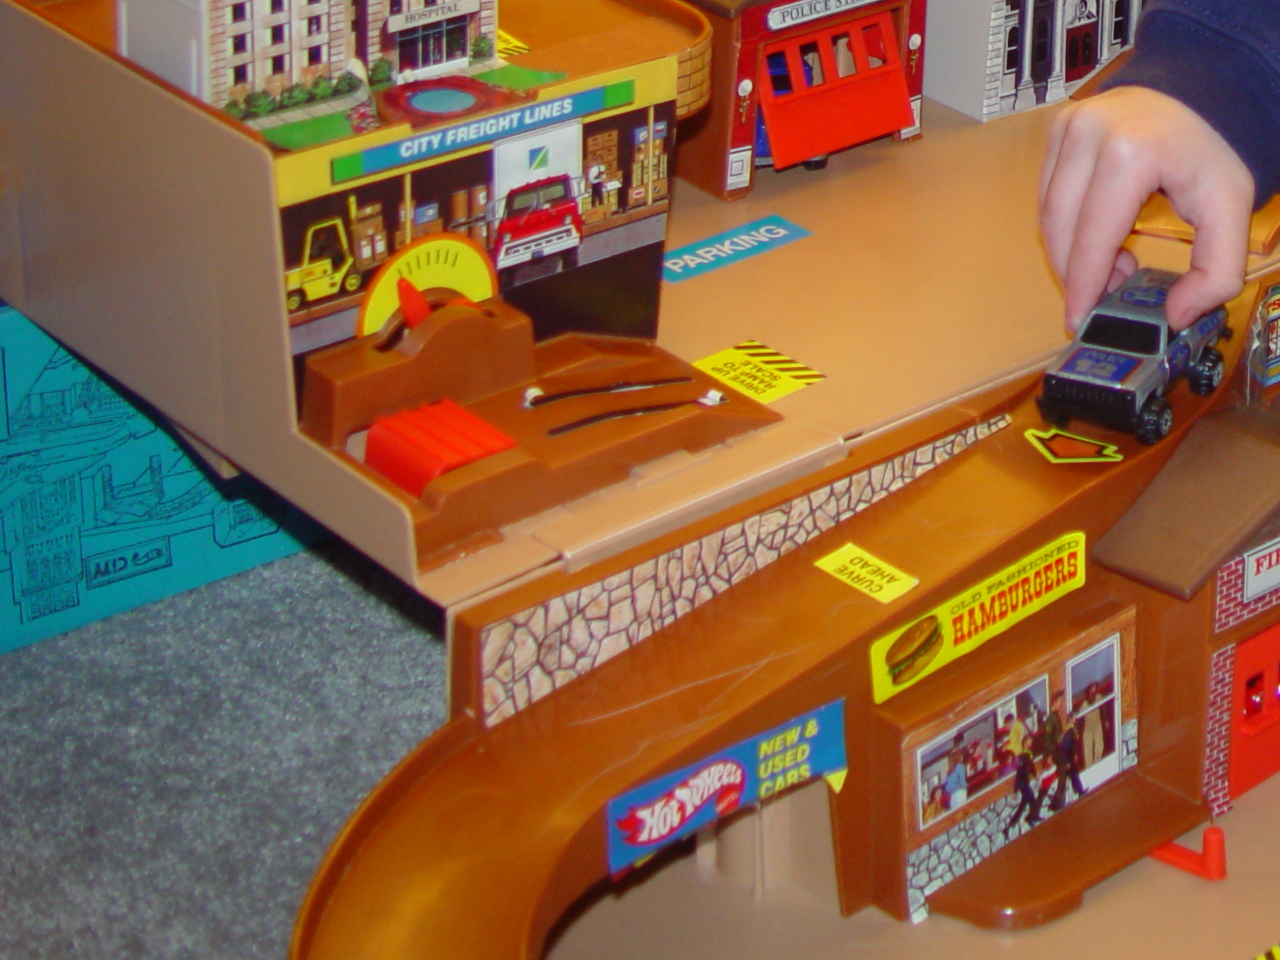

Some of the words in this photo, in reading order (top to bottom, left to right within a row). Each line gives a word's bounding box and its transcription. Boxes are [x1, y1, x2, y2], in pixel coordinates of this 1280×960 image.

[405, 3, 460, 24] HOSPITAL
[780, 0, 831, 24] POLICE
[400, 132, 442, 158] CITY
[445, 112, 522, 146] FREIGHT
[524, 98, 573, 124] LINES
[663, 225, 789, 273] PARKING
[711, 366, 730, 377] UP
[723, 362, 741, 372] TO
[740, 360, 782, 381] SCALE
[740, 371, 777, 389] RAMP
[728, 374, 767, 395] DRIVE
[833, 564, 884, 594] CURVE
[849, 556, 901, 584] AHEAD
[951, 592, 982, 615] OLD
[985, 540, 1079, 595] FASHIONED
[952, 550, 1078, 648] HAMBURGERS
[758, 725, 801, 759] NEW
[805, 718, 818, 738] &
[758, 743, 810, 779] USED
[758, 764, 812, 800] CARS
